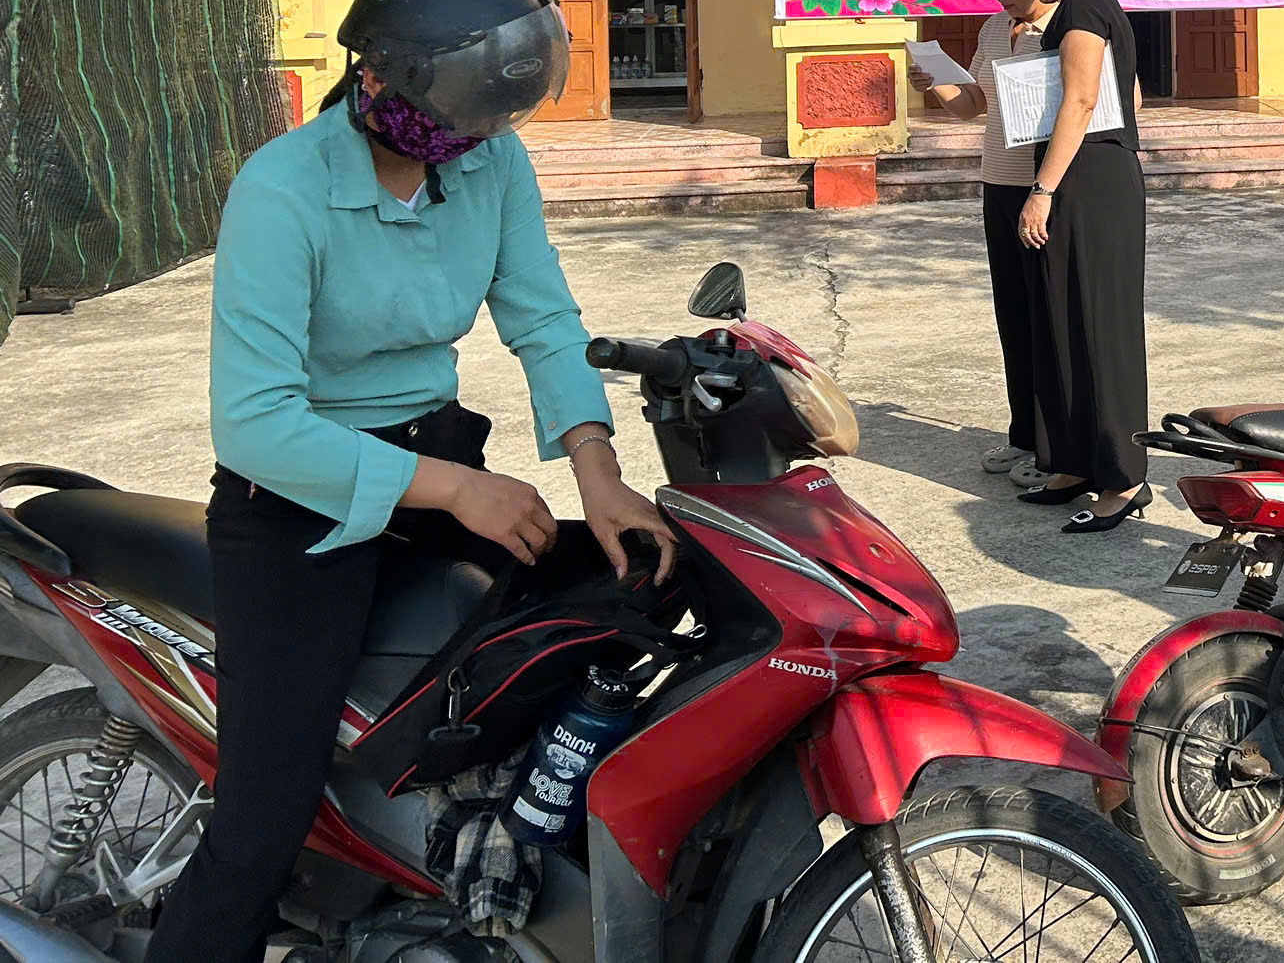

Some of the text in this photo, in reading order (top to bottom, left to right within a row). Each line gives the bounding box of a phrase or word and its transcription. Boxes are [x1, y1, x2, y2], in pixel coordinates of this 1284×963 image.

[95, 612, 129, 630] 110
[105, 603, 213, 658] Wave
[768, 657, 838, 681] HONDA
[553, 724, 596, 755] DRINK
[528, 767, 573, 799] LOVE
[534, 788, 574, 807] YOURSELF
